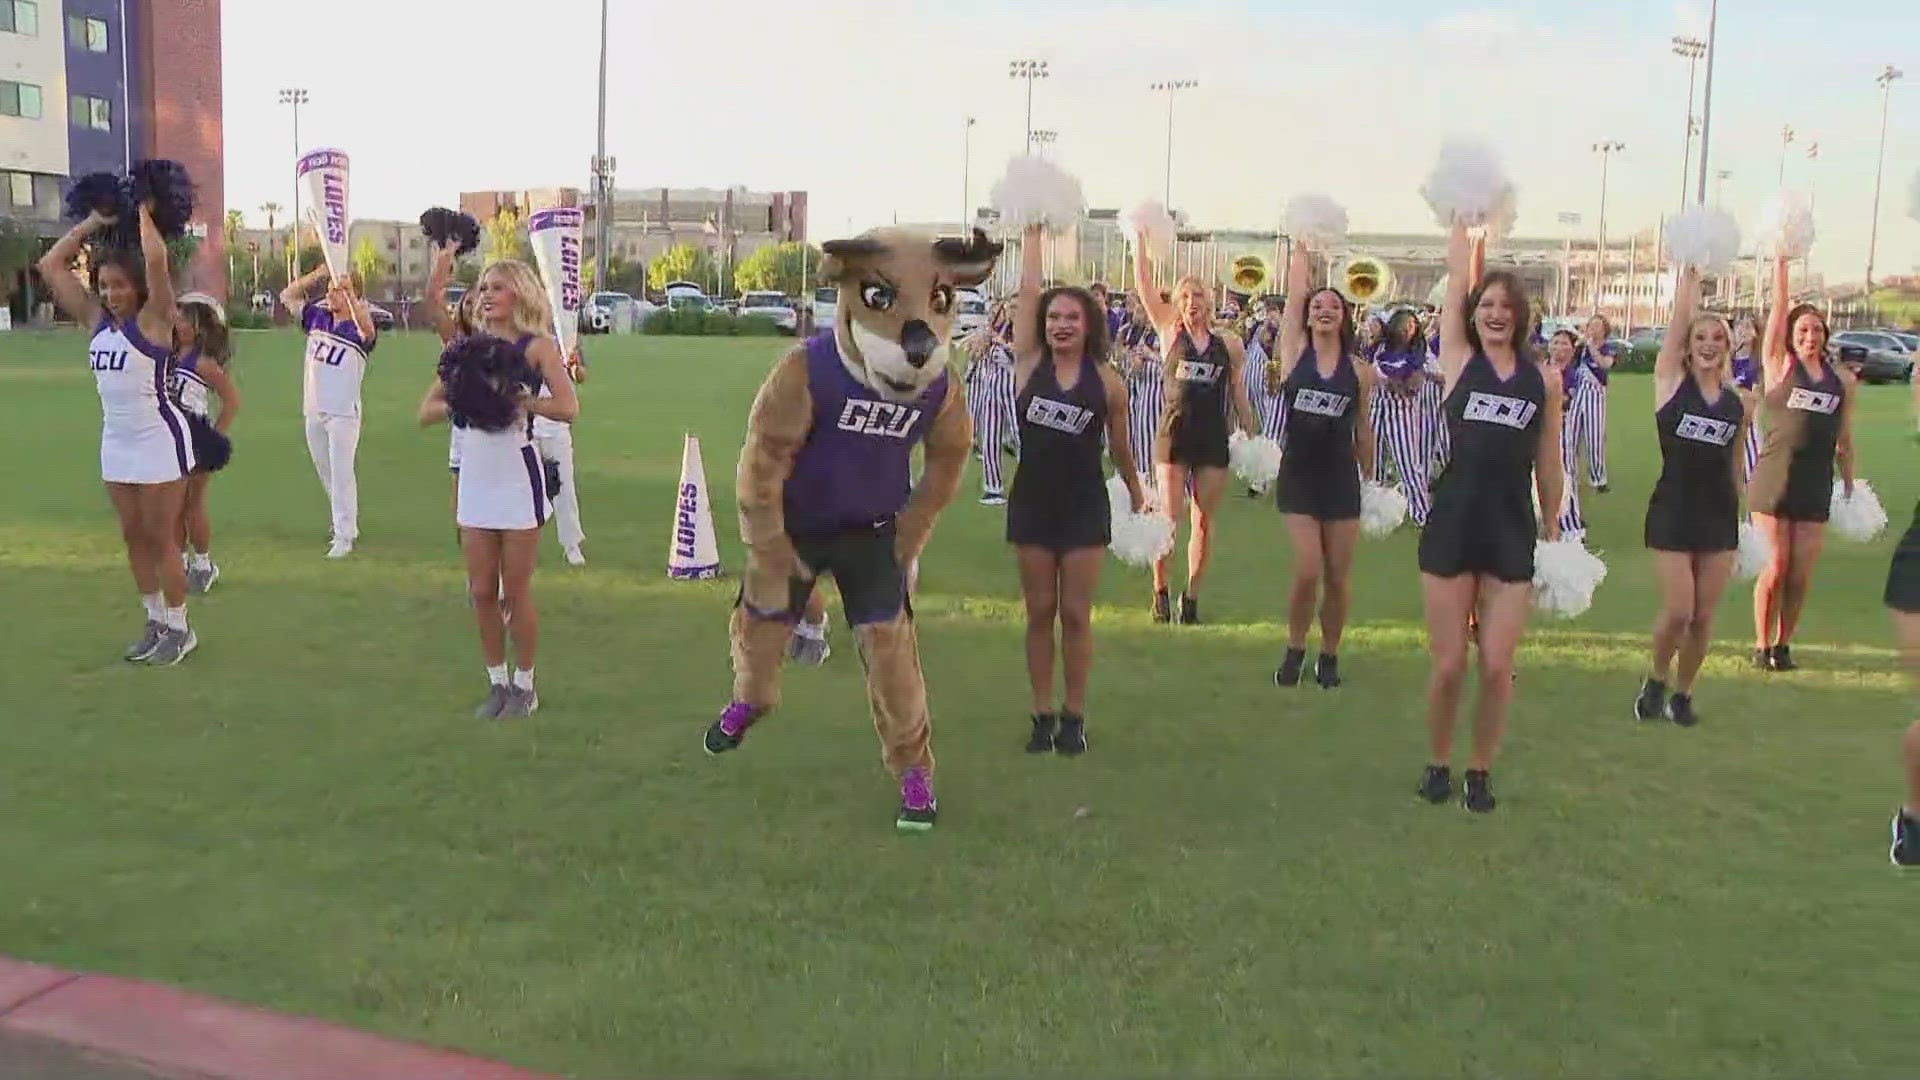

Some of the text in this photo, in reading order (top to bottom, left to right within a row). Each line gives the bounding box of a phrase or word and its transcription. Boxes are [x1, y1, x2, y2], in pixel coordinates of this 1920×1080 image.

[324, 173, 345, 245] LOPES
[561, 236, 580, 311] LOPES
[837, 397, 922, 438] GCU
[1026, 395, 1095, 435] GCU
[1293, 388, 1352, 417] GCU
[1461, 391, 1537, 430] GCU
[1786, 387, 1841, 414] GCU
[1675, 413, 1737, 446] GCU
[676, 483, 697, 558] LOPES
